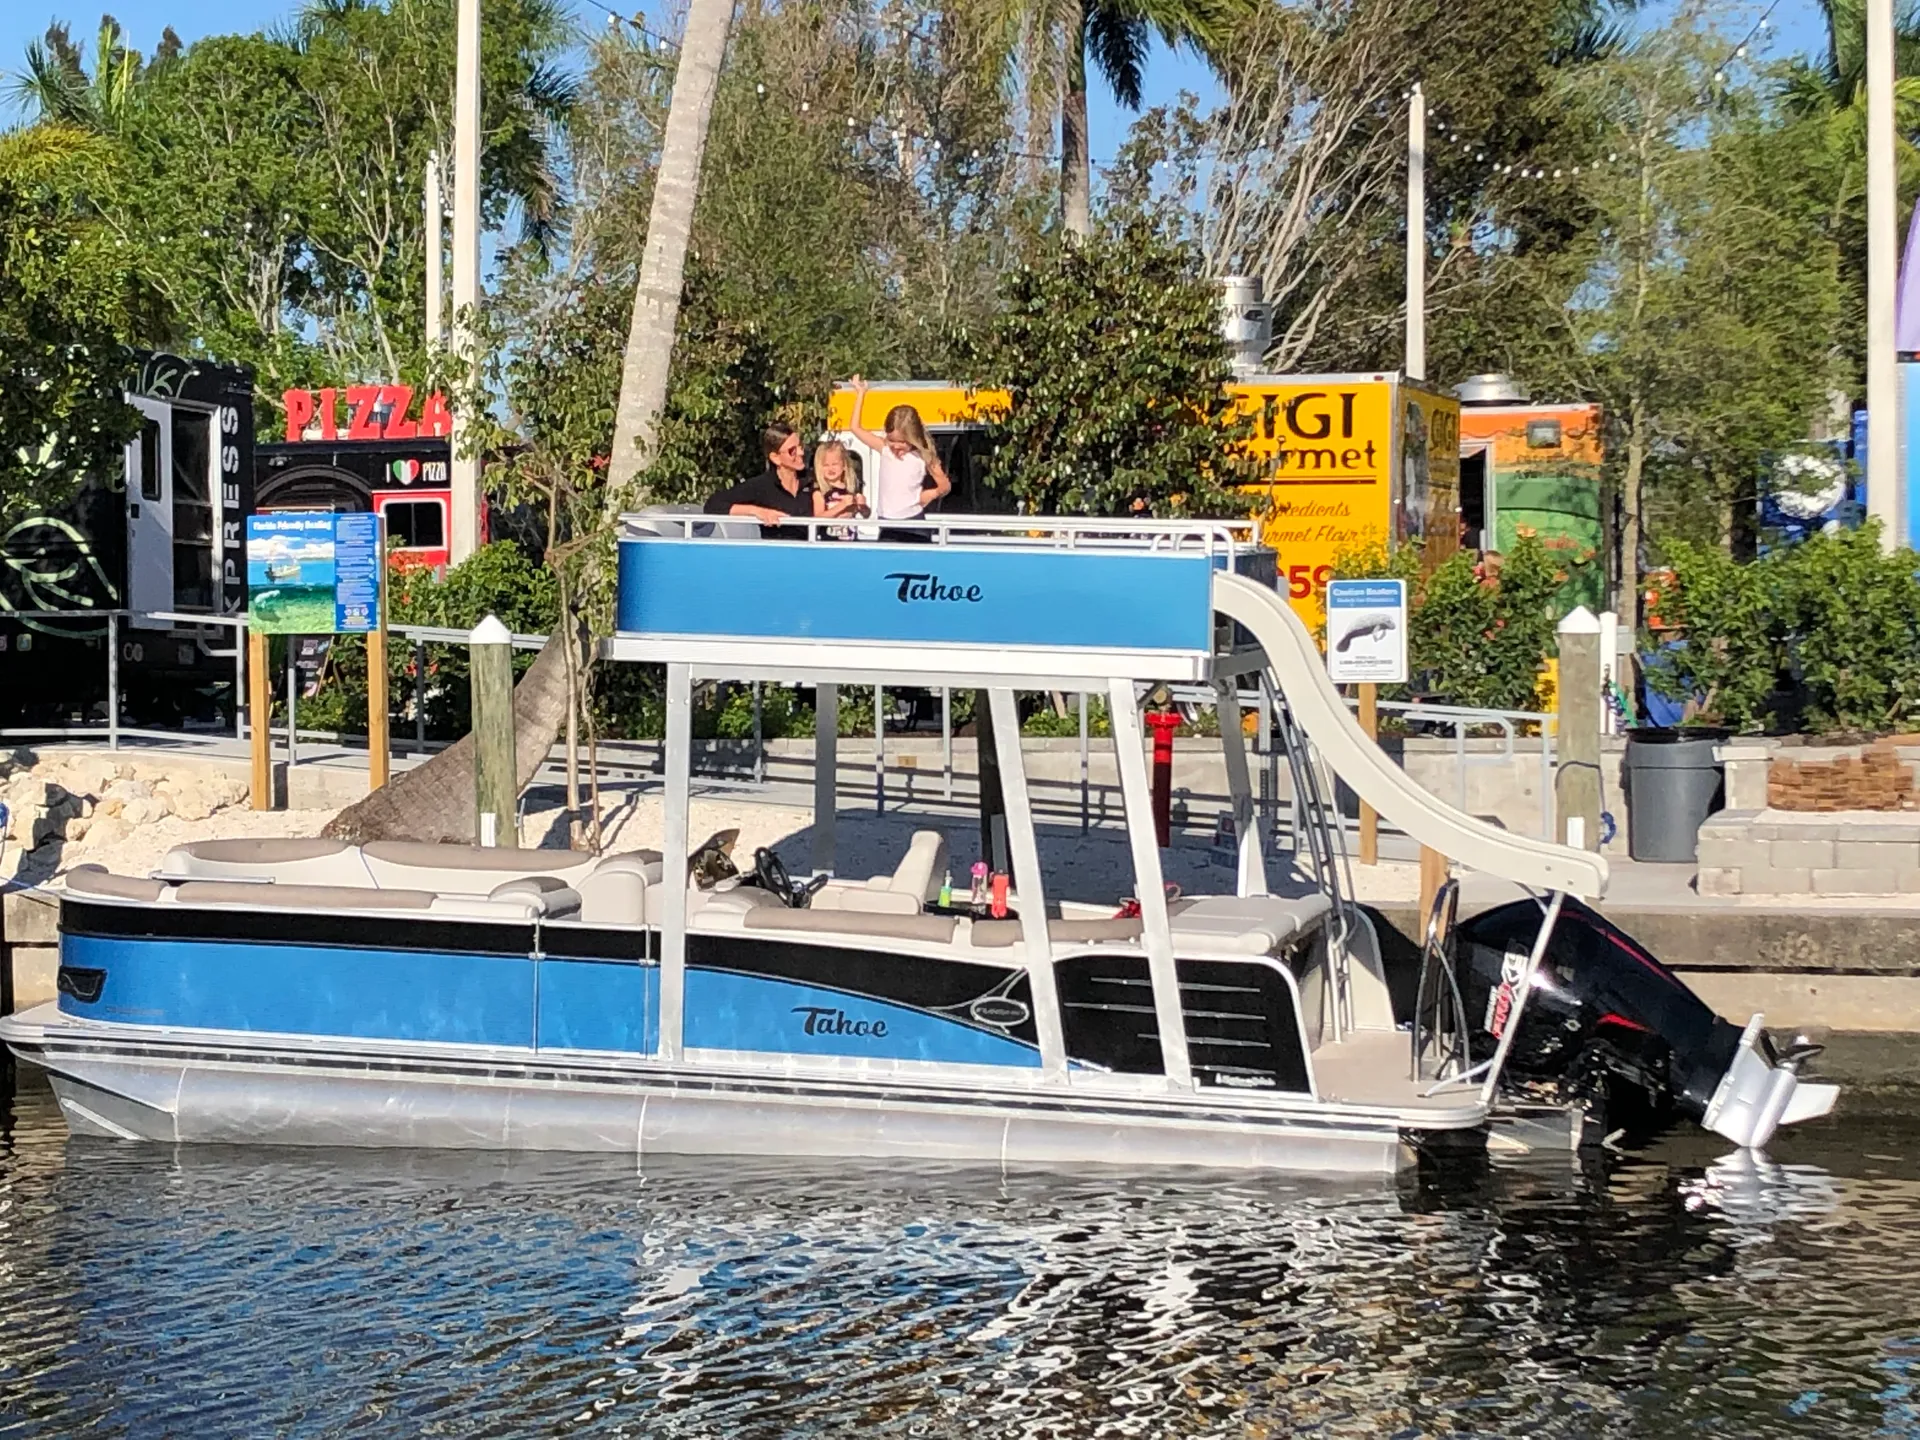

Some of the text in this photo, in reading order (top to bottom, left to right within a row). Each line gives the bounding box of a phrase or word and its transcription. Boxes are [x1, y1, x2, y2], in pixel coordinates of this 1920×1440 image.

[282, 385, 452, 442] PIZZA
[1235, 392, 1359, 440] IGI
[385, 461, 447, 483] I PIZZA
[883, 572, 984, 604] Tahoe
[790, 1006, 889, 1038] Tahoe
